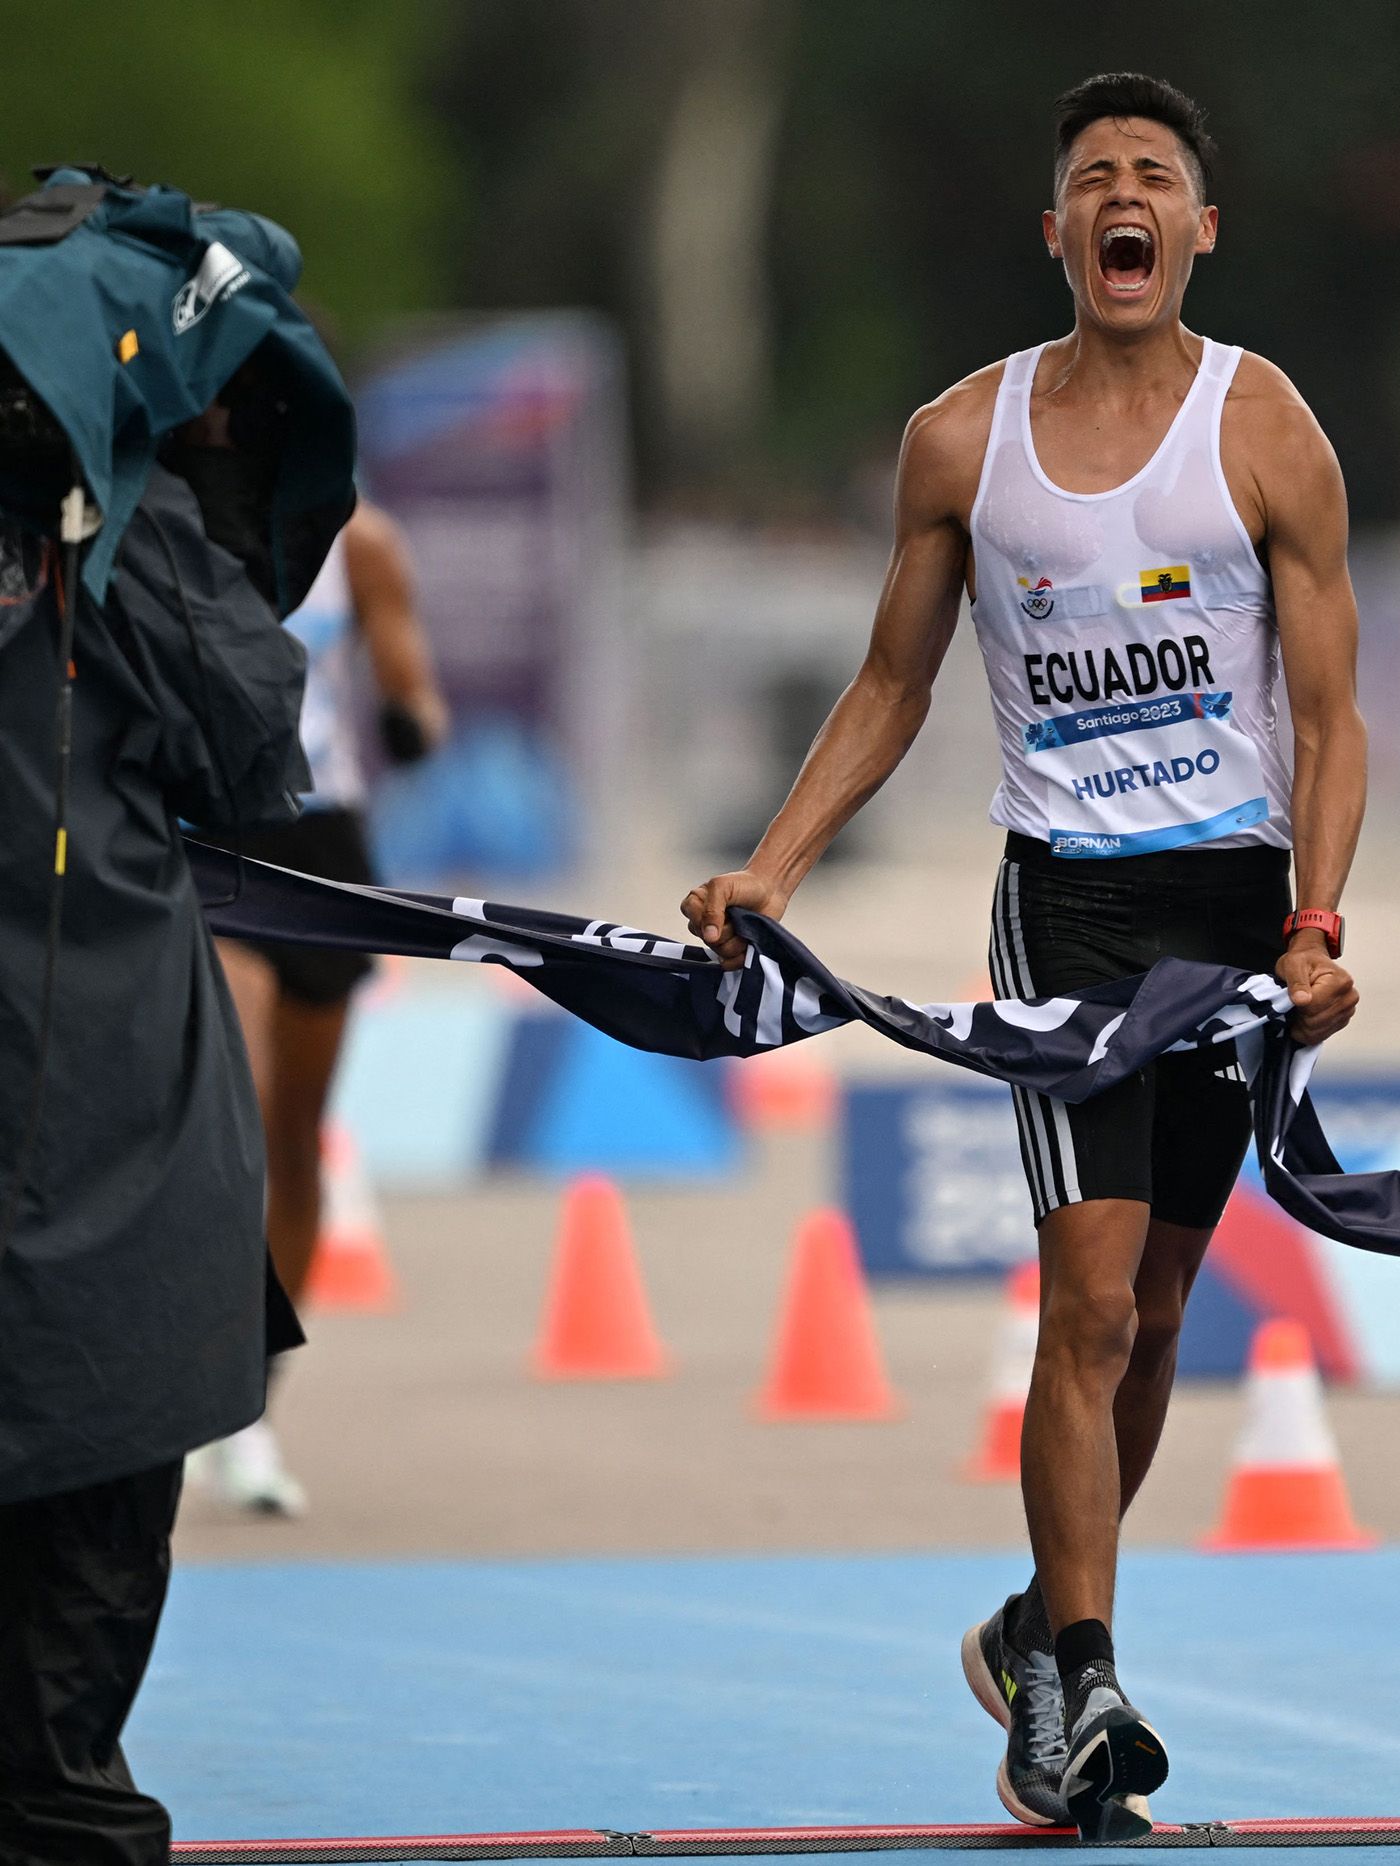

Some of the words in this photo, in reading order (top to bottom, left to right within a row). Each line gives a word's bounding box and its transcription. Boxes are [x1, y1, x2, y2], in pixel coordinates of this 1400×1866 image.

[1024, 635, 1215, 705] ECUADOR
[1076, 706, 1139, 731] Santiago
[1071, 748, 1220, 801] HURTADO
[1055, 836, 1121, 849] BORNAN
